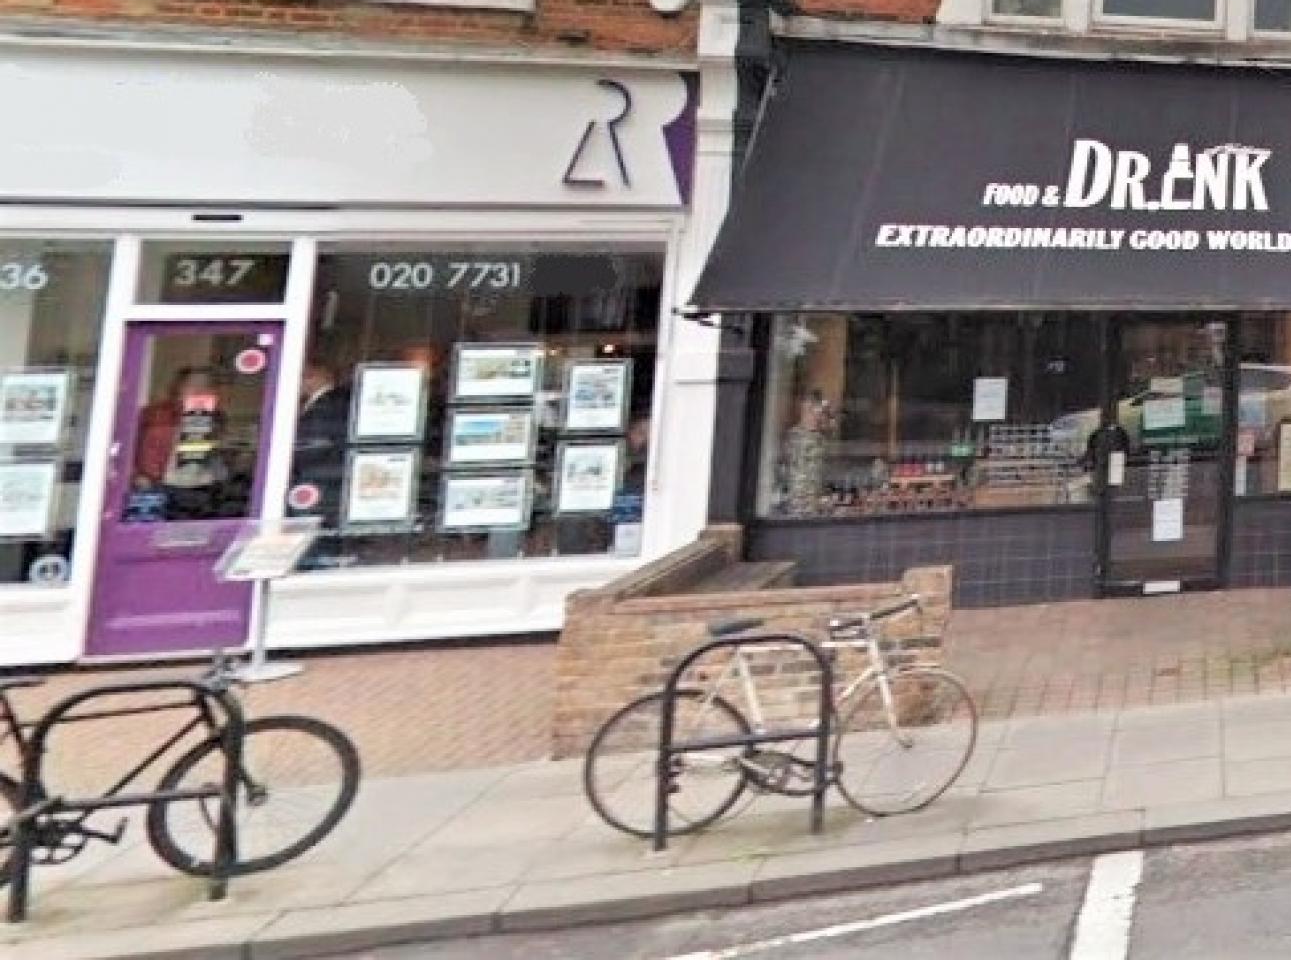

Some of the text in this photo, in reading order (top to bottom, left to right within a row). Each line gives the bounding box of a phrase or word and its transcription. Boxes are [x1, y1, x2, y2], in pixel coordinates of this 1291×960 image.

[983, 182, 1040, 207] FOOD
[1042, 184, 1061, 207] &
[875, 224, 1128, 251] EXTRAORDINARILY
[1128, 230, 1200, 251] GOOD
[173, 259, 256, 287] 347
[369, 261, 521, 289] 020 7731
